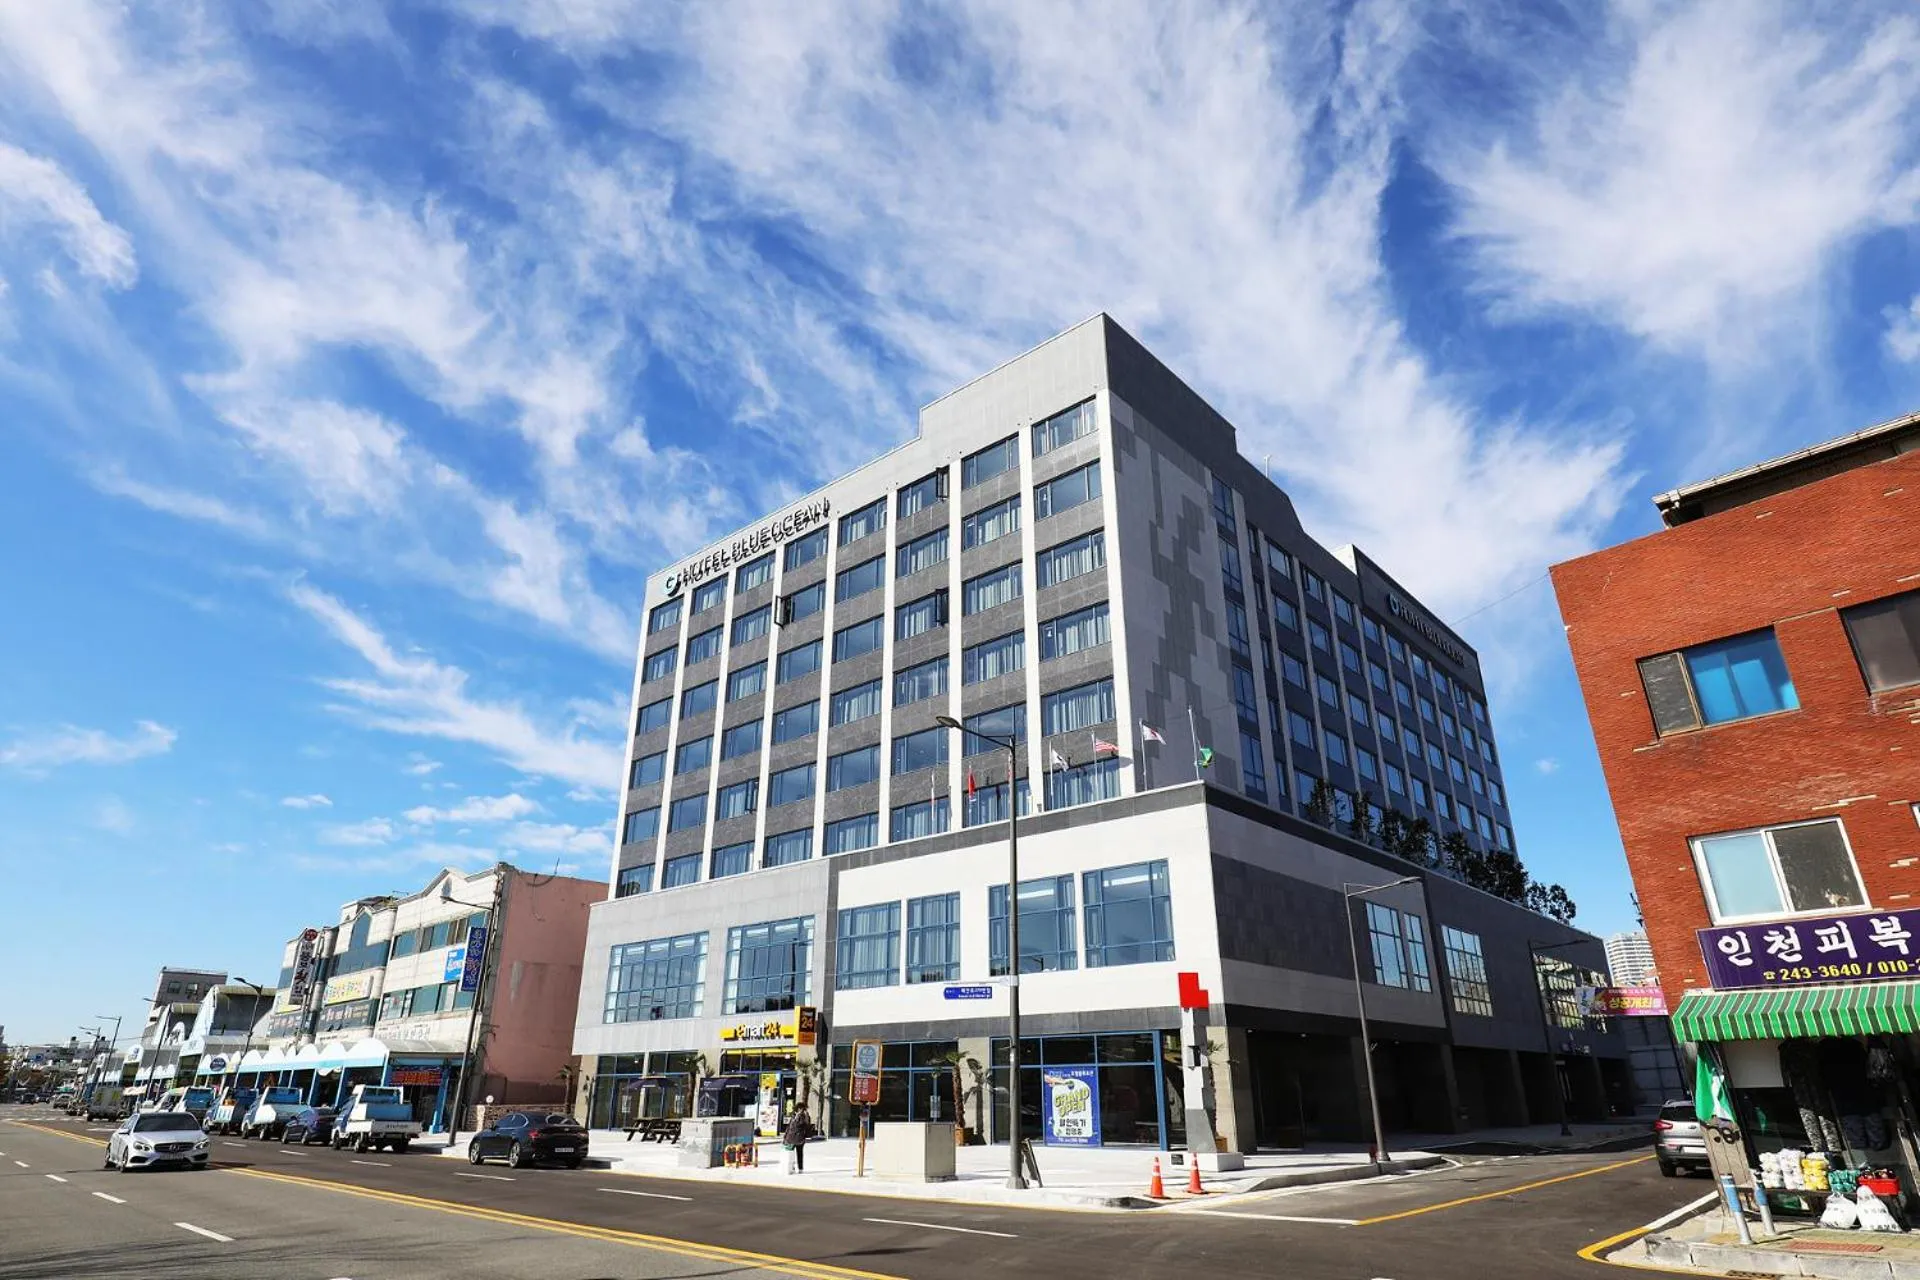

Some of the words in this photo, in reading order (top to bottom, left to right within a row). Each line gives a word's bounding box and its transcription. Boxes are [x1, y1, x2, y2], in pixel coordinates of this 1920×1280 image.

[682, 549, 731, 589] HOTEL
[1717, 916, 1912, 967] 인천피복
[1781, 962, 1862, 981] 243-3640
[736, 1022, 781, 1039] emart24
[801, 1016, 814, 1030] 24
[1055, 1087, 1090, 1108] GRAND
[1059, 1099, 1086, 1118] OPEN
